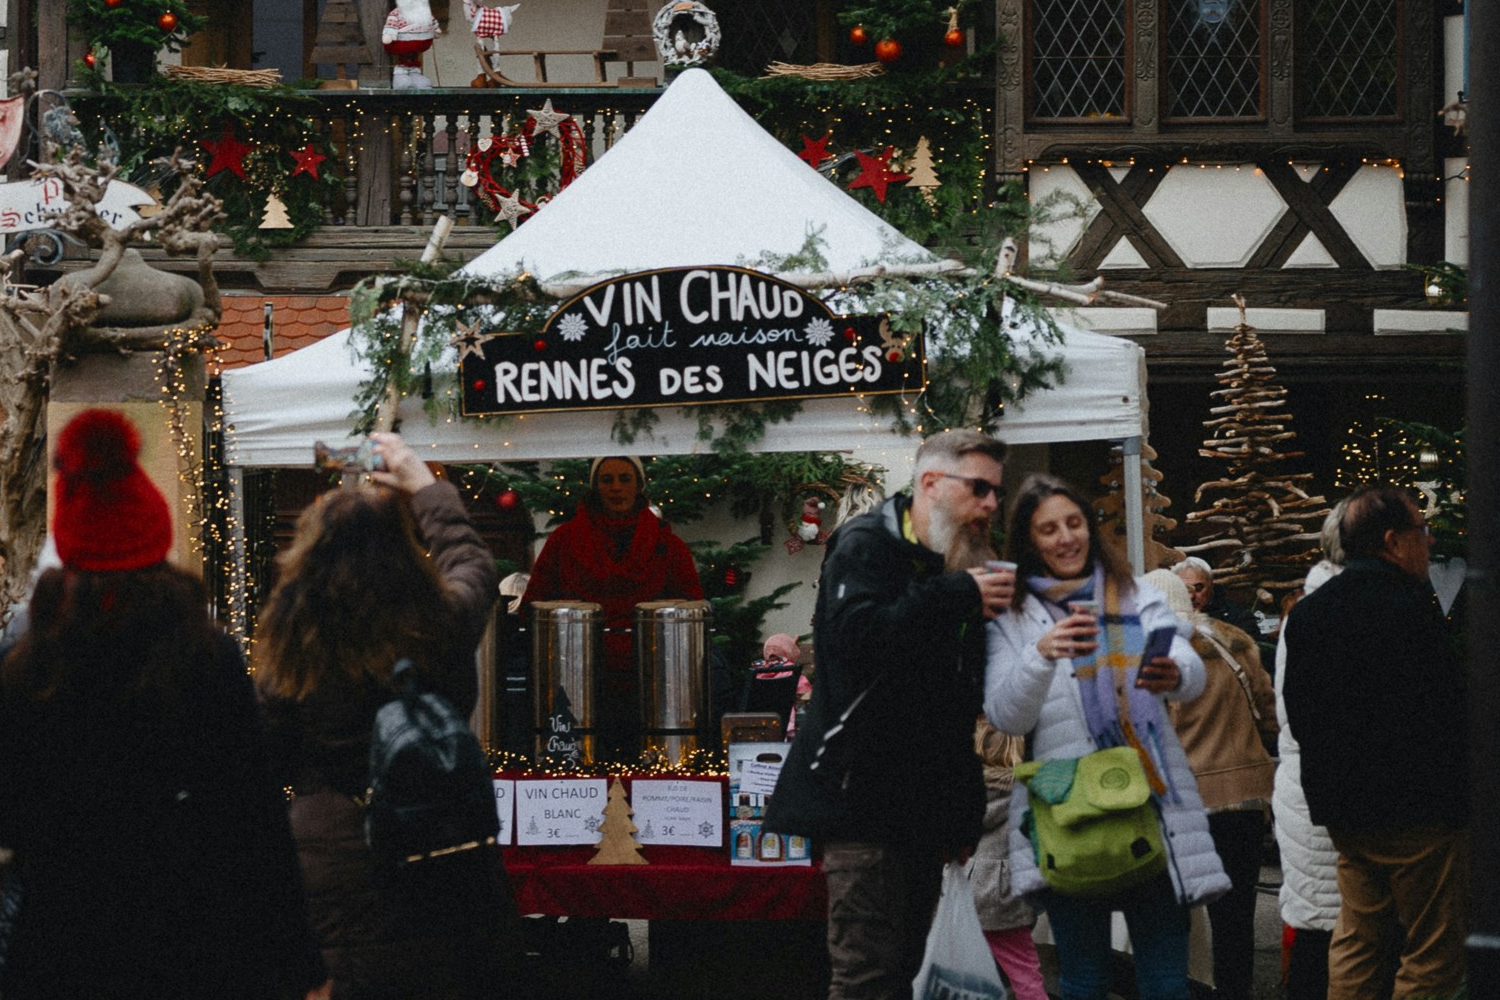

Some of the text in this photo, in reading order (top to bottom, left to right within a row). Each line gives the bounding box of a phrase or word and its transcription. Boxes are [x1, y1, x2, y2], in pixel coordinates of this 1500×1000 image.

[584, 270, 804, 327] VIN CHAUD
[604, 321, 677, 365] fait
[495, 345, 883, 403] RENNES DES NEIGES
[549, 714, 571, 733] Vin
[525, 787, 598, 799] VIN CHAUD
[544, 809, 582, 819] BLANC
[547, 828, 561, 838] 3€
[662, 825, 676, 836] 3€
